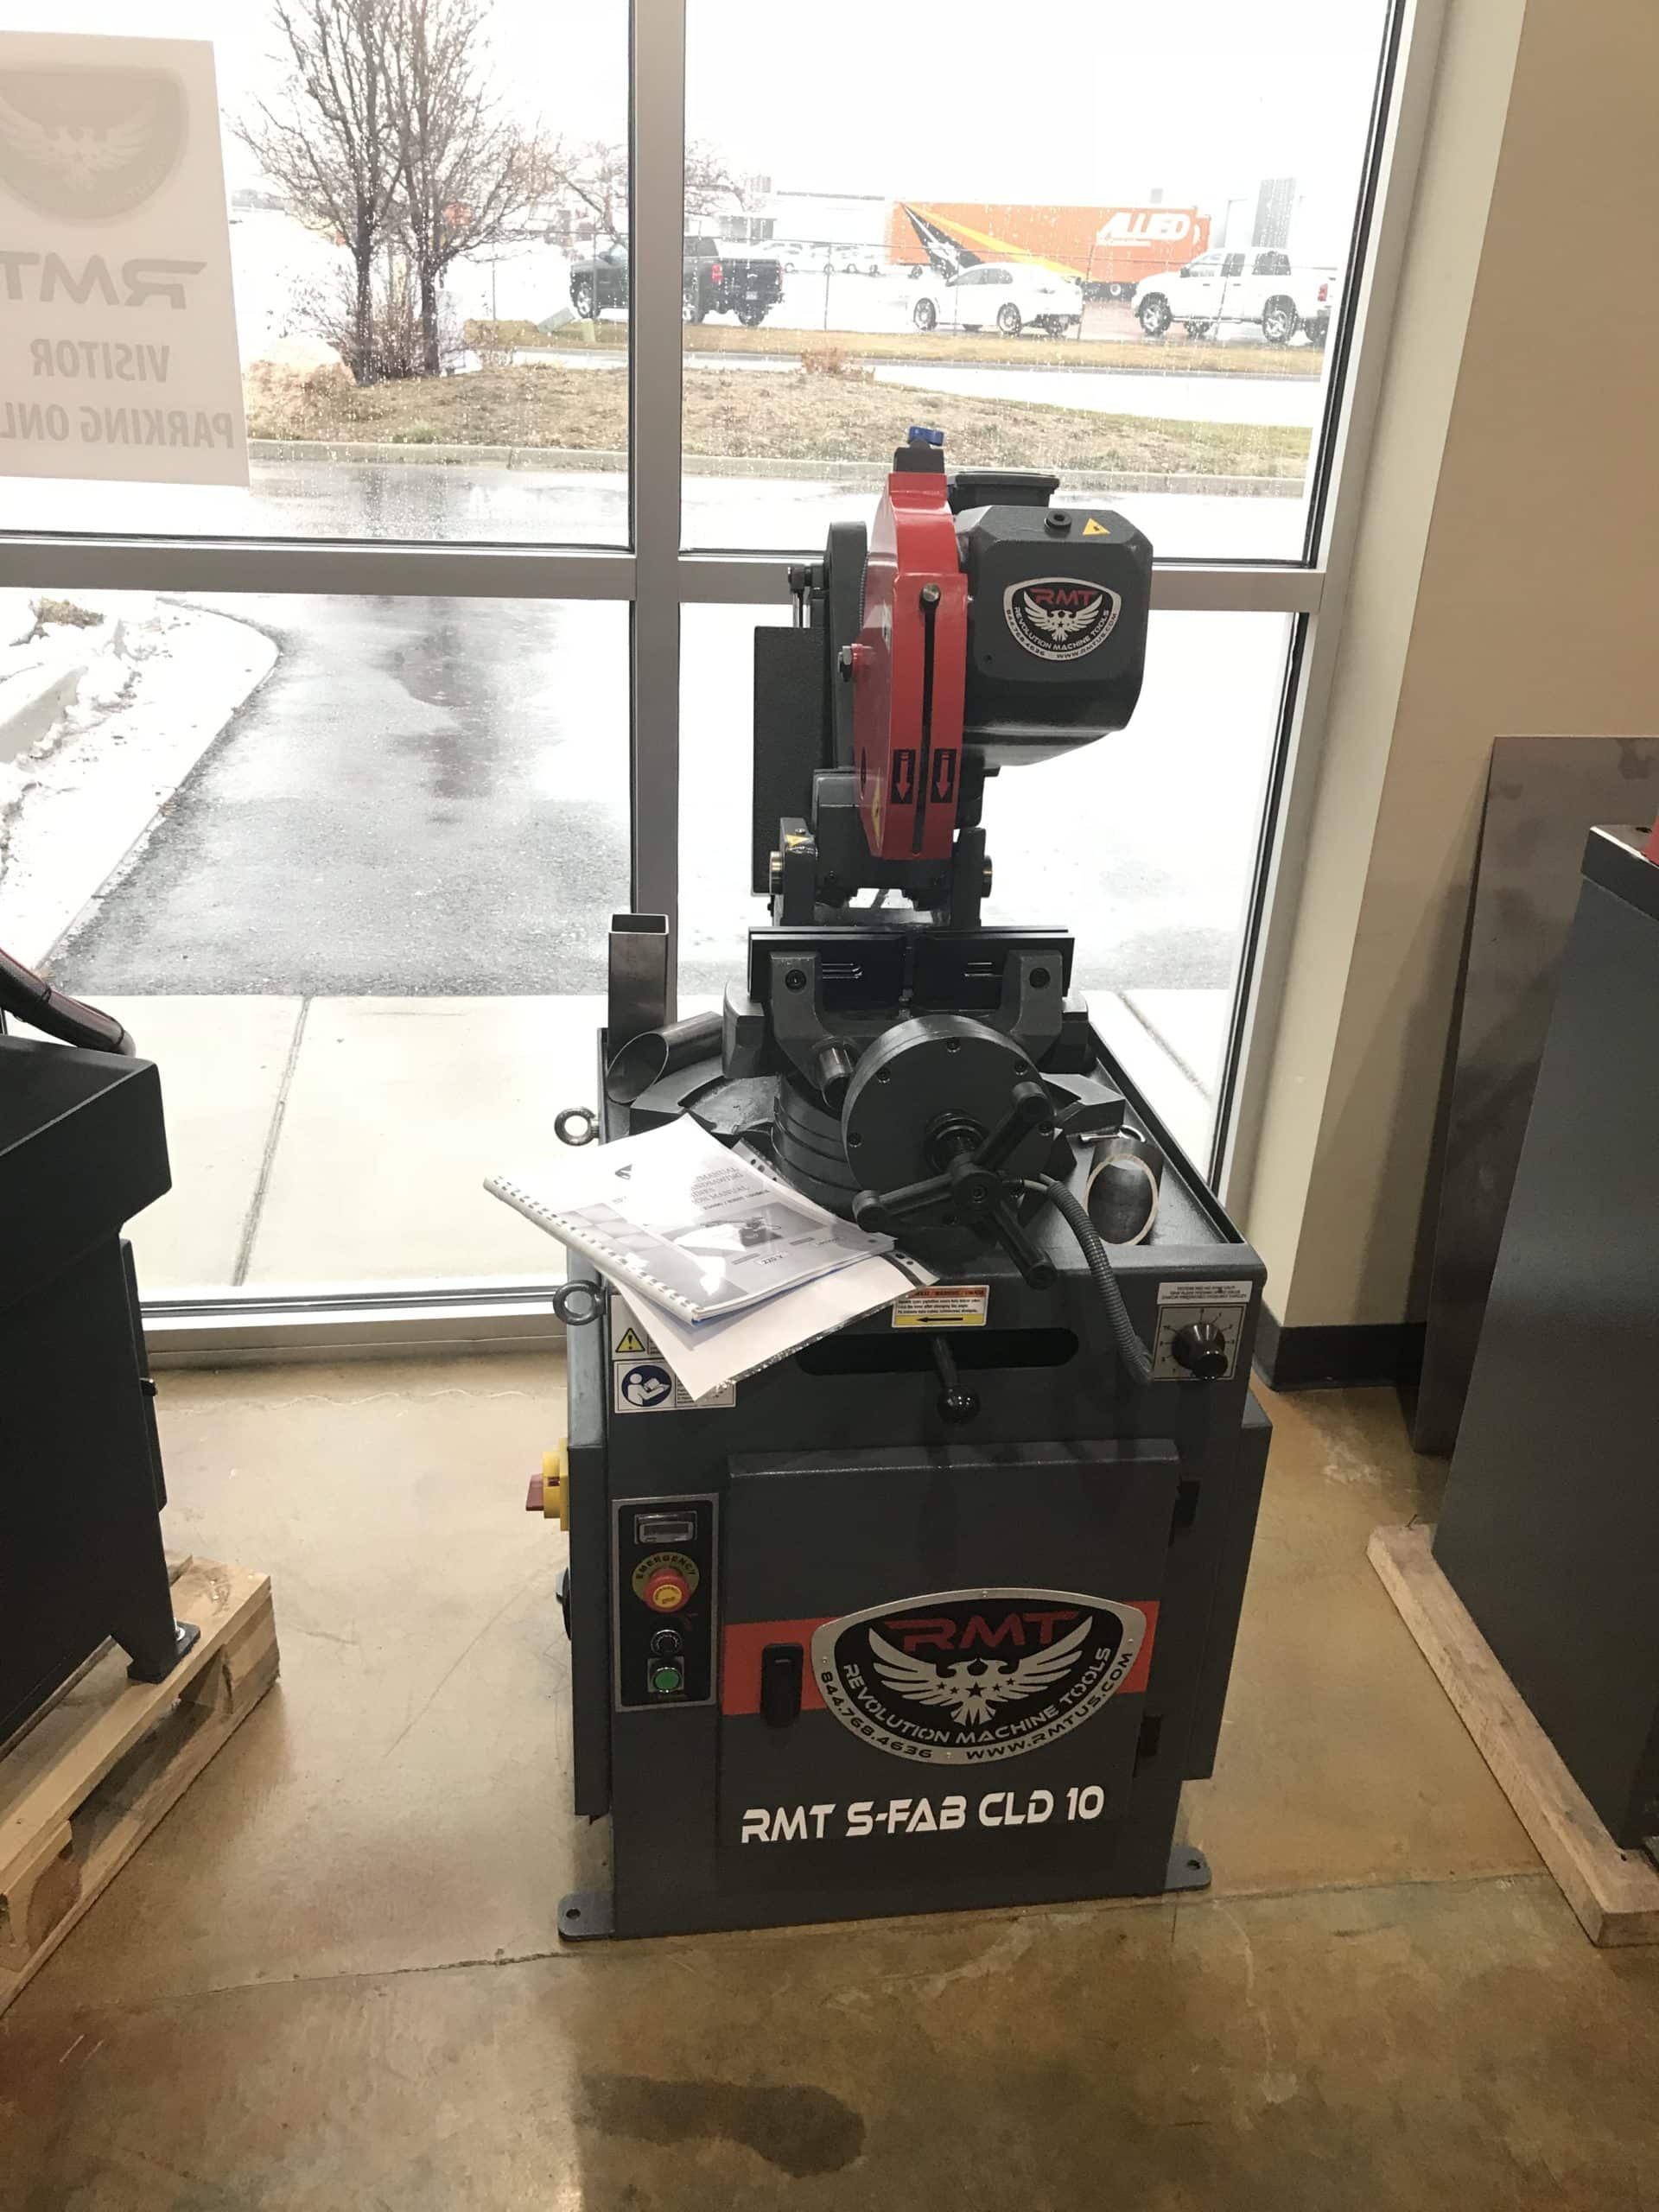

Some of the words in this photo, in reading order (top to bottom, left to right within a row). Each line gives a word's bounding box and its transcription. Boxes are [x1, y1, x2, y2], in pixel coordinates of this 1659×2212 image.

[1096, 213, 1191, 241] ALLIED
[1030, 588, 1099, 606] RMT
[1014, 607, 1052, 649] REVOLUTION
[1052, 635, 1091, 651] MACHINE
[1090, 609, 1110, 638] TOOLS
[636, 1554, 696, 1580] EMERGENCY
[884, 1611, 1079, 1653] RMT
[820, 1670, 932, 1760] 844.768.4636
[842, 1662, 950, 1744] REVOLUTION
[955, 1704, 1059, 1745] MACHINE
[1059, 1646, 1112, 1707] TOOLS
[965, 1652, 1134, 1760] WWW.RMTUS.COM
[741, 1803, 836, 1844] RMT
[845, 1795, 967, 1837] S-FAB
[978, 1789, 1055, 1827] CLD
[1066, 1785, 1105, 1821] 10
